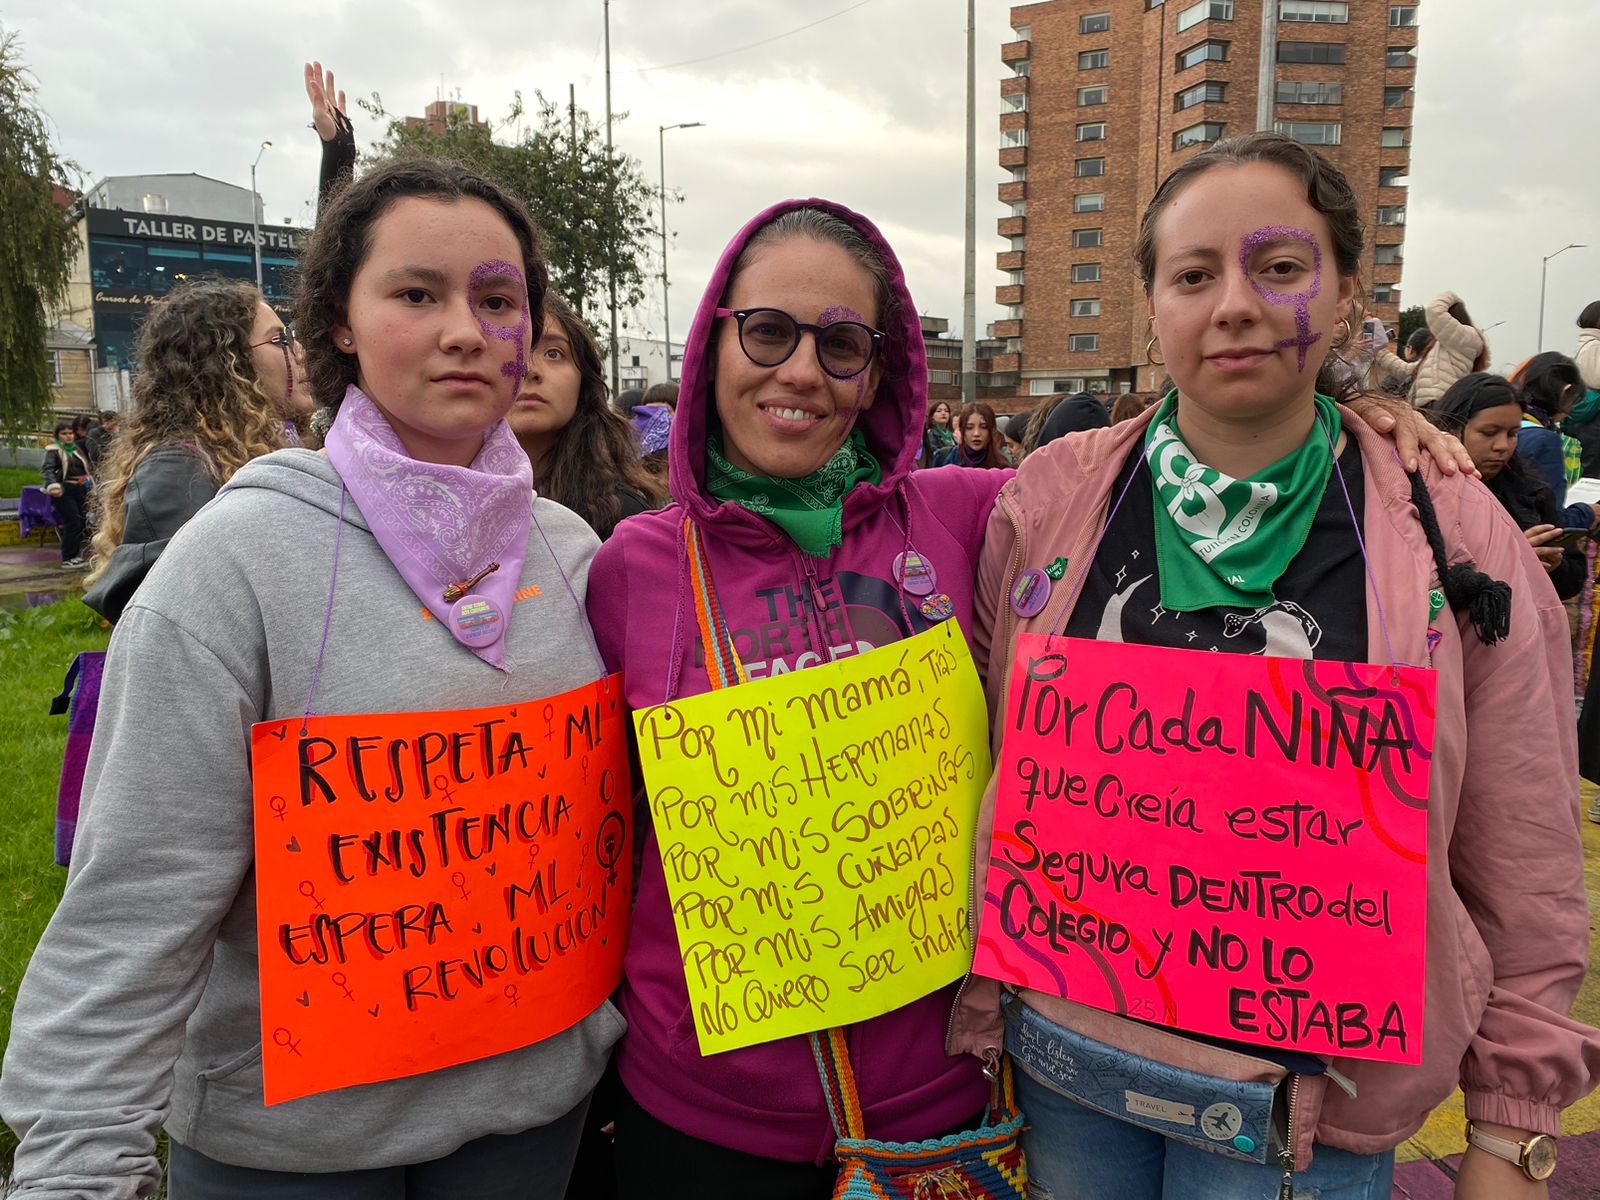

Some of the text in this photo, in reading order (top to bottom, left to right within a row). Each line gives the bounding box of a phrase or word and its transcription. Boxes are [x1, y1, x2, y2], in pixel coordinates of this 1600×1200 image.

[123, 218, 197, 240] TALLER
[202, 226, 228, 242] DE
[1237, 494, 1271, 533] COLOIA
[756, 576, 842, 622] THE
[1016, 653, 1414, 773] Por Cada NIÑA
[298, 701, 602, 807] RESPETA MI
[328, 794, 574, 885] EXISTENCIA
[1016, 757, 1364, 848] que Creía estar
[1003, 820, 1393, 936] Segura DENTRO del
[278, 901, 454, 966] ESPERA
[1000, 878, 1314, 985] COLEGIO y NO LO
[1228, 986, 1408, 1054] ESTABA
[1134, 1099, 1168, 1113] TRAVEL
